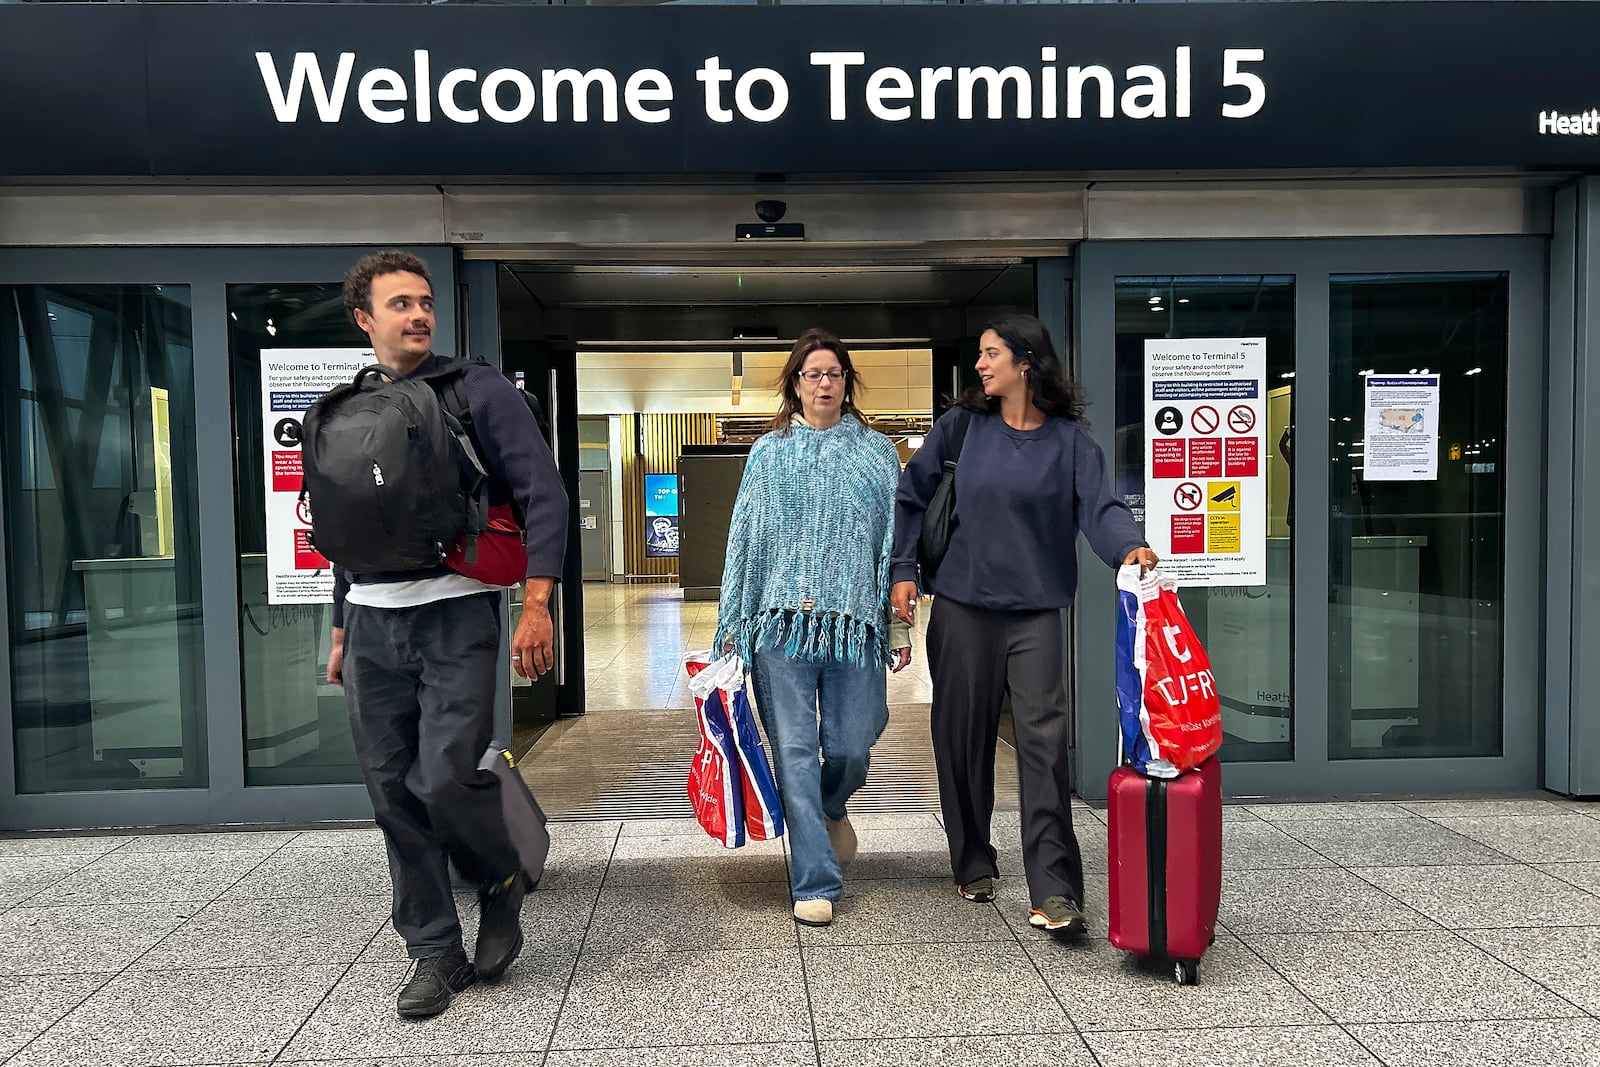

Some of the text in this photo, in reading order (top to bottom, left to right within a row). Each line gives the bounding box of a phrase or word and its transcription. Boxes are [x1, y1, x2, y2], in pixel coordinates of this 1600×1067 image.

[255, 46, 1266, 124] Welcome to Terminal 5
[1152, 351, 1246, 361] Welcome to Terminal 5
[268, 363, 309, 371] Welcome
[311, 363, 320, 371] to
[322, 362, 360, 371] Terminal
[1175, 364, 1191, 372] safety
[1226, 363, 1245, 371] please
[293, 374, 311, 382] safety
[1184, 370, 1210, 378] following
[302, 380, 331, 388] following
